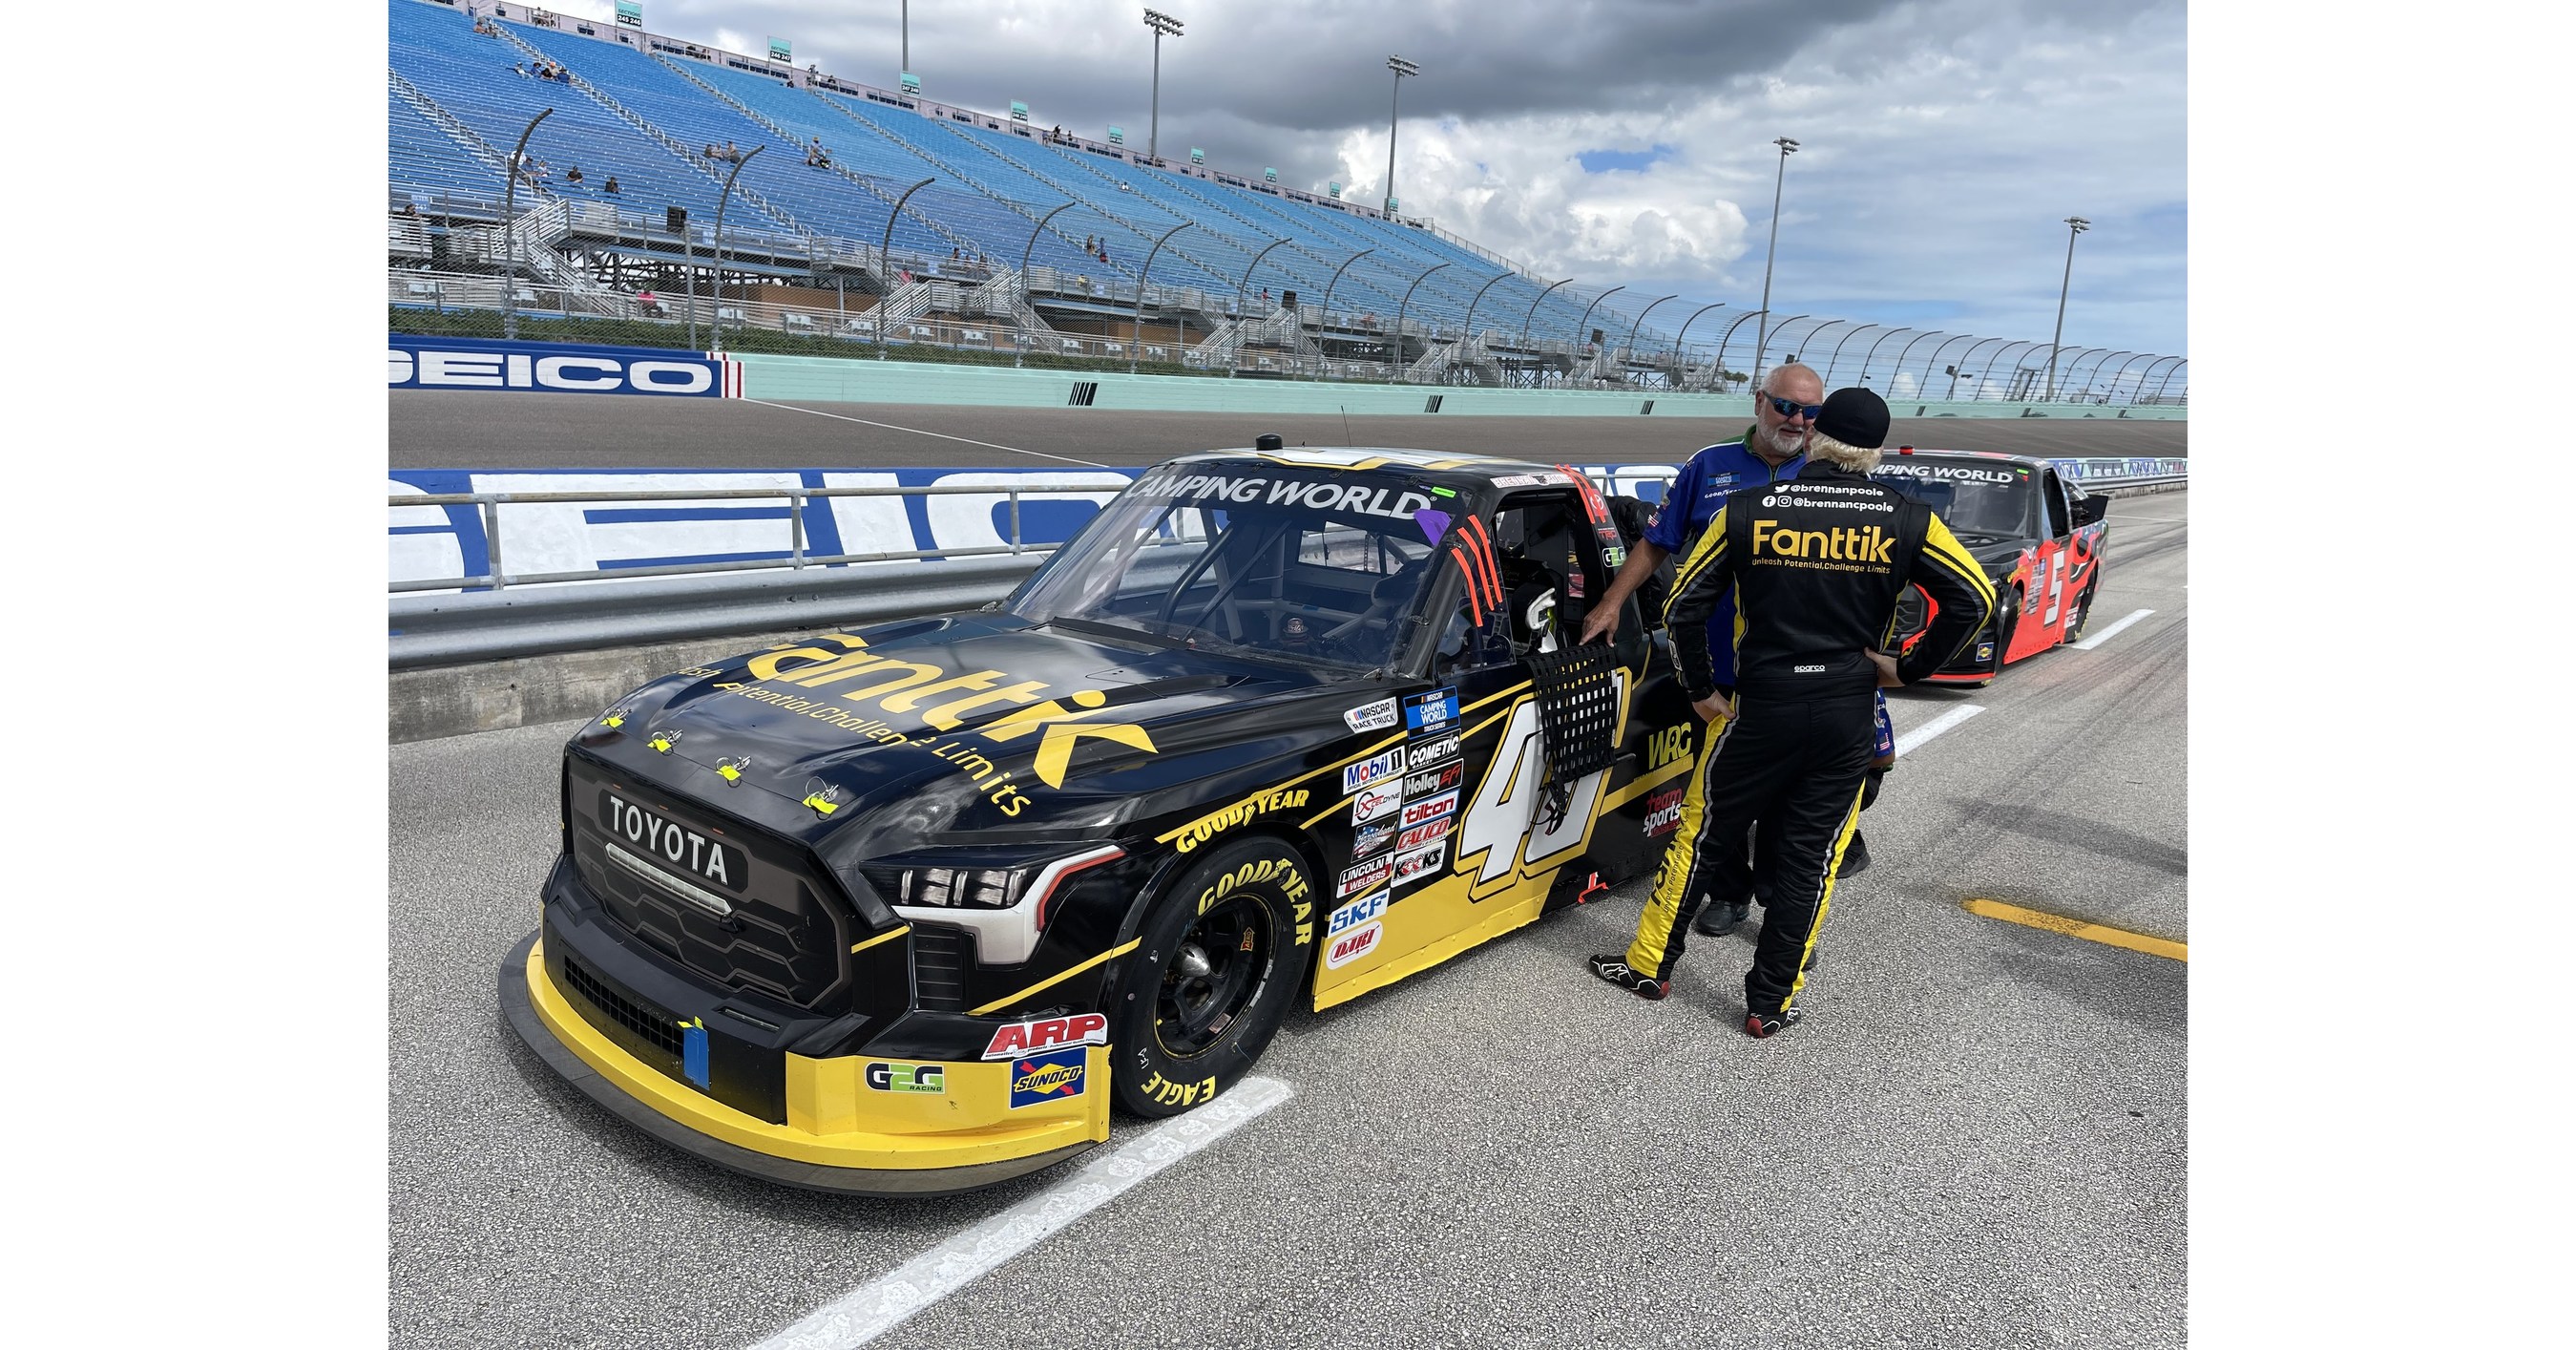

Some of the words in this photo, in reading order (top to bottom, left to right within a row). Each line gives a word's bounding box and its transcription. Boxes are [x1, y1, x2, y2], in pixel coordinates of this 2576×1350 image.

[618, 14, 629, 23] 245
[1934, 467, 2014, 484] WORLD
[1124, 475, 1267, 503] CAMPING
[1266, 480, 1433, 520] WORLD
[1791, 484, 1884, 496] @brennanpoole
[1793, 496, 1894, 513] @brennancpoole
[1752, 519, 1896, 563] Fanttik
[1751, 557, 1782, 566] Unleash
[1867, 565, 1891, 574] Limits
[2043, 550, 2064, 627] 5
[1794, 665, 1826, 674] sparco
[1419, 700, 1447, 714] CAMPING
[1427, 691, 1443, 702] NASCAR
[1352, 720, 1372, 730] RACE
[1372, 714, 1395, 726] TRUCK
[1361, 702, 1391, 719] NASCAR
[1421, 708, 1448, 725] WORLD
[1409, 735, 1459, 766] COMETIC
[1648, 722, 1691, 770] WRG
[932, 741, 1032, 818] Limits
[1348, 755, 1388, 786] Mobil
[1393, 751, 1399, 768] 1
[1405, 772, 1441, 796] Holley
[1405, 797, 1455, 824] tilton
[1646, 789, 1683, 814] team
[1176, 790, 1309, 853] GOODYEAR
[1643, 801, 1681, 837] sports
[610, 795, 728, 886] TOYOTA
[1397, 818, 1450, 850] CALICO
[1342, 856, 1386, 883] LINCOLN
[1393, 848, 1442, 879] KOOKS
[1351, 869, 1387, 890] WELDERS
[1198, 858, 1313, 946] GOODYEAR
[1330, 893, 1387, 934] SKF
[987, 1015, 1105, 1054] ARP
[866, 1063, 944, 1090] G2G
[1016, 1066, 1082, 1093] SUNOCO
[1141, 1070, 1217, 1107] EAGLE
